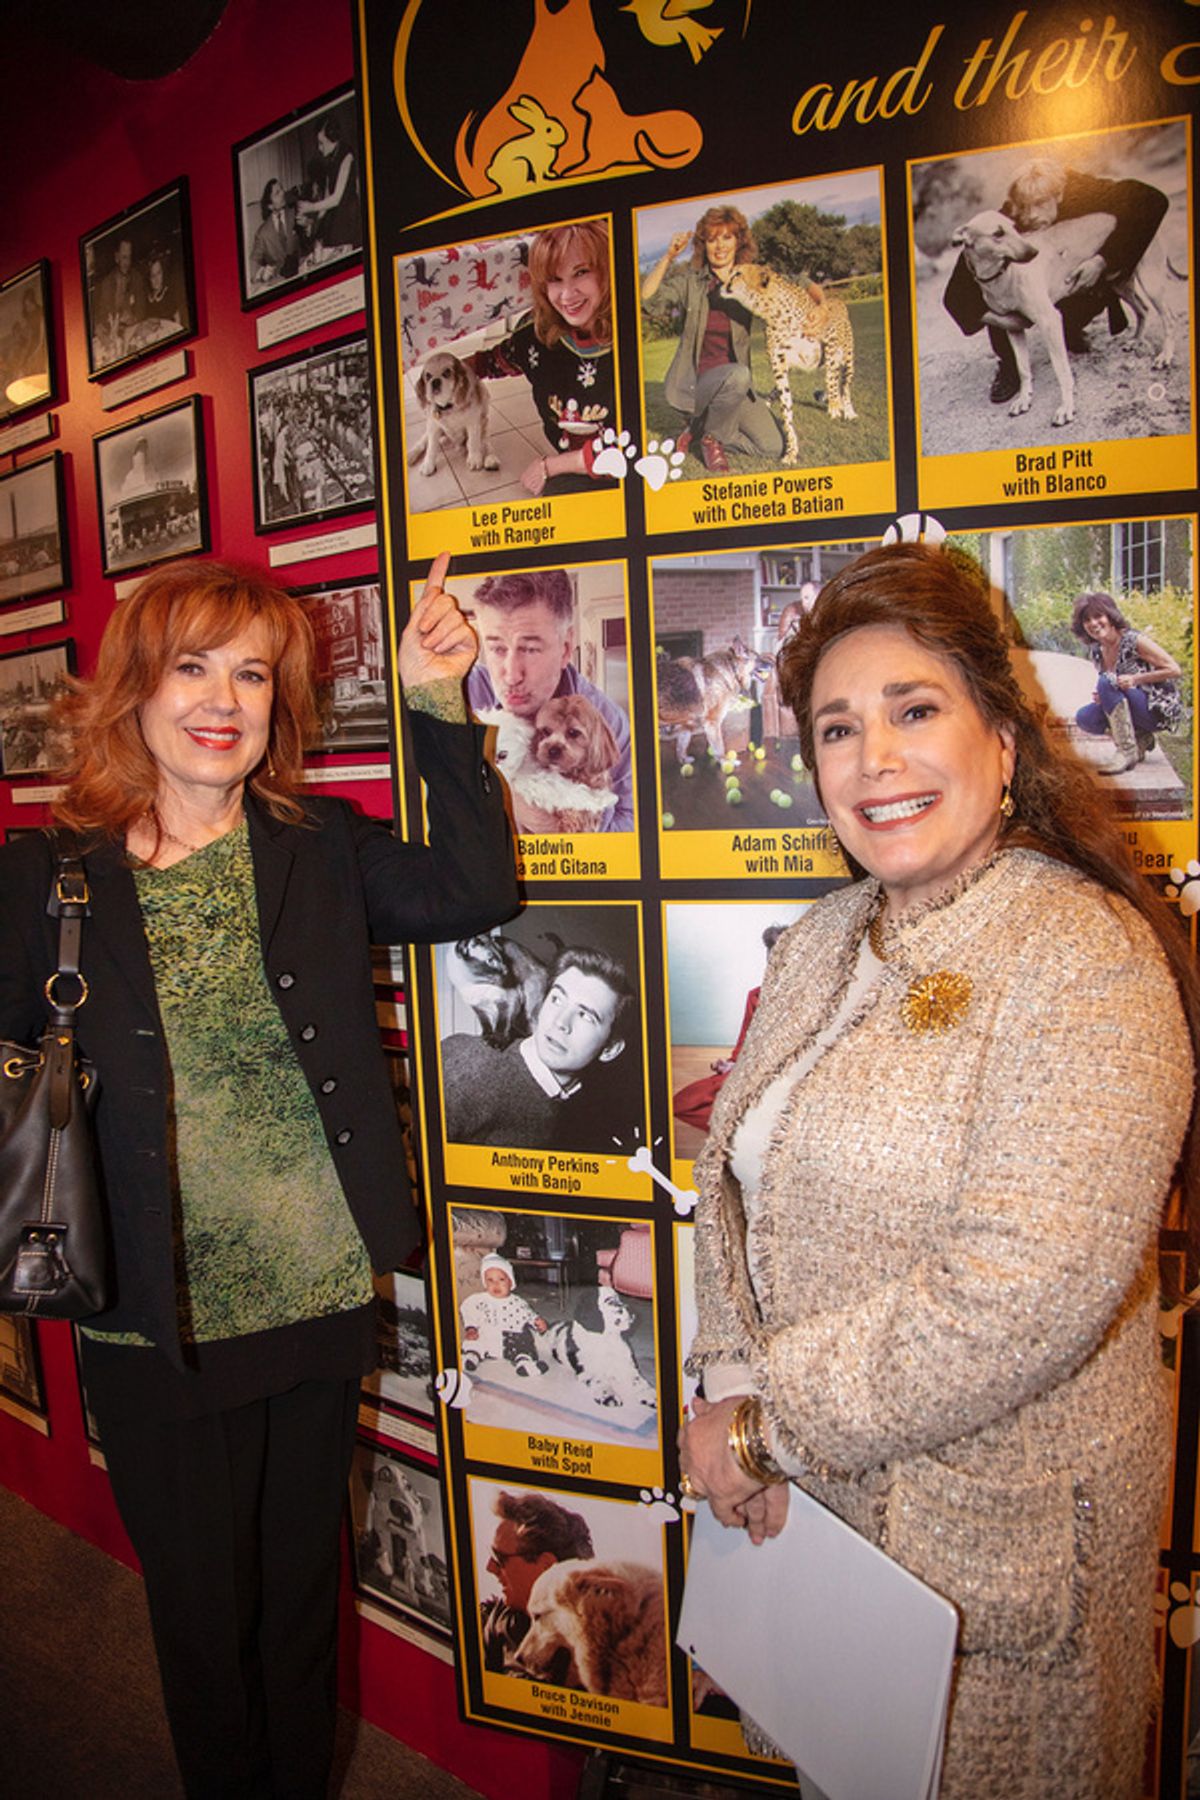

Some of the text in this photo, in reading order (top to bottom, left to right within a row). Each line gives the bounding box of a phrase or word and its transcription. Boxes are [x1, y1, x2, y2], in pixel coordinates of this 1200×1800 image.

[792, 24, 945, 136] and
[953, 10, 1138, 111] their
[1016, 449, 1093, 473] Brad Pitt
[702, 475, 833, 502] Stefanie Powers
[1002, 473, 1107, 497] with Blanco
[472, 502, 552, 527] Lee Purcell
[693, 495, 844, 524] with Cheeta Batian
[470, 526, 556, 547] with Ranger
[518, 838, 574, 855] Baldwin
[731, 833, 828, 852] Adam Schiff
[530, 859, 557, 875] and
[560, 858, 607, 875] Gitana
[745, 855, 814, 873] with Mia
[1134, 850, 1174, 868] Bear
[491, 1152, 600, 1174] Anthony Perkins
[510, 1172, 582, 1193] with Banjo
[527, 1436, 593, 1458] Baby Reid
[531, 1455, 592, 1474] with Spot
[531, 1685, 620, 1714] Bruce Davison
[540, 1704, 612, 1727] with Jennie
